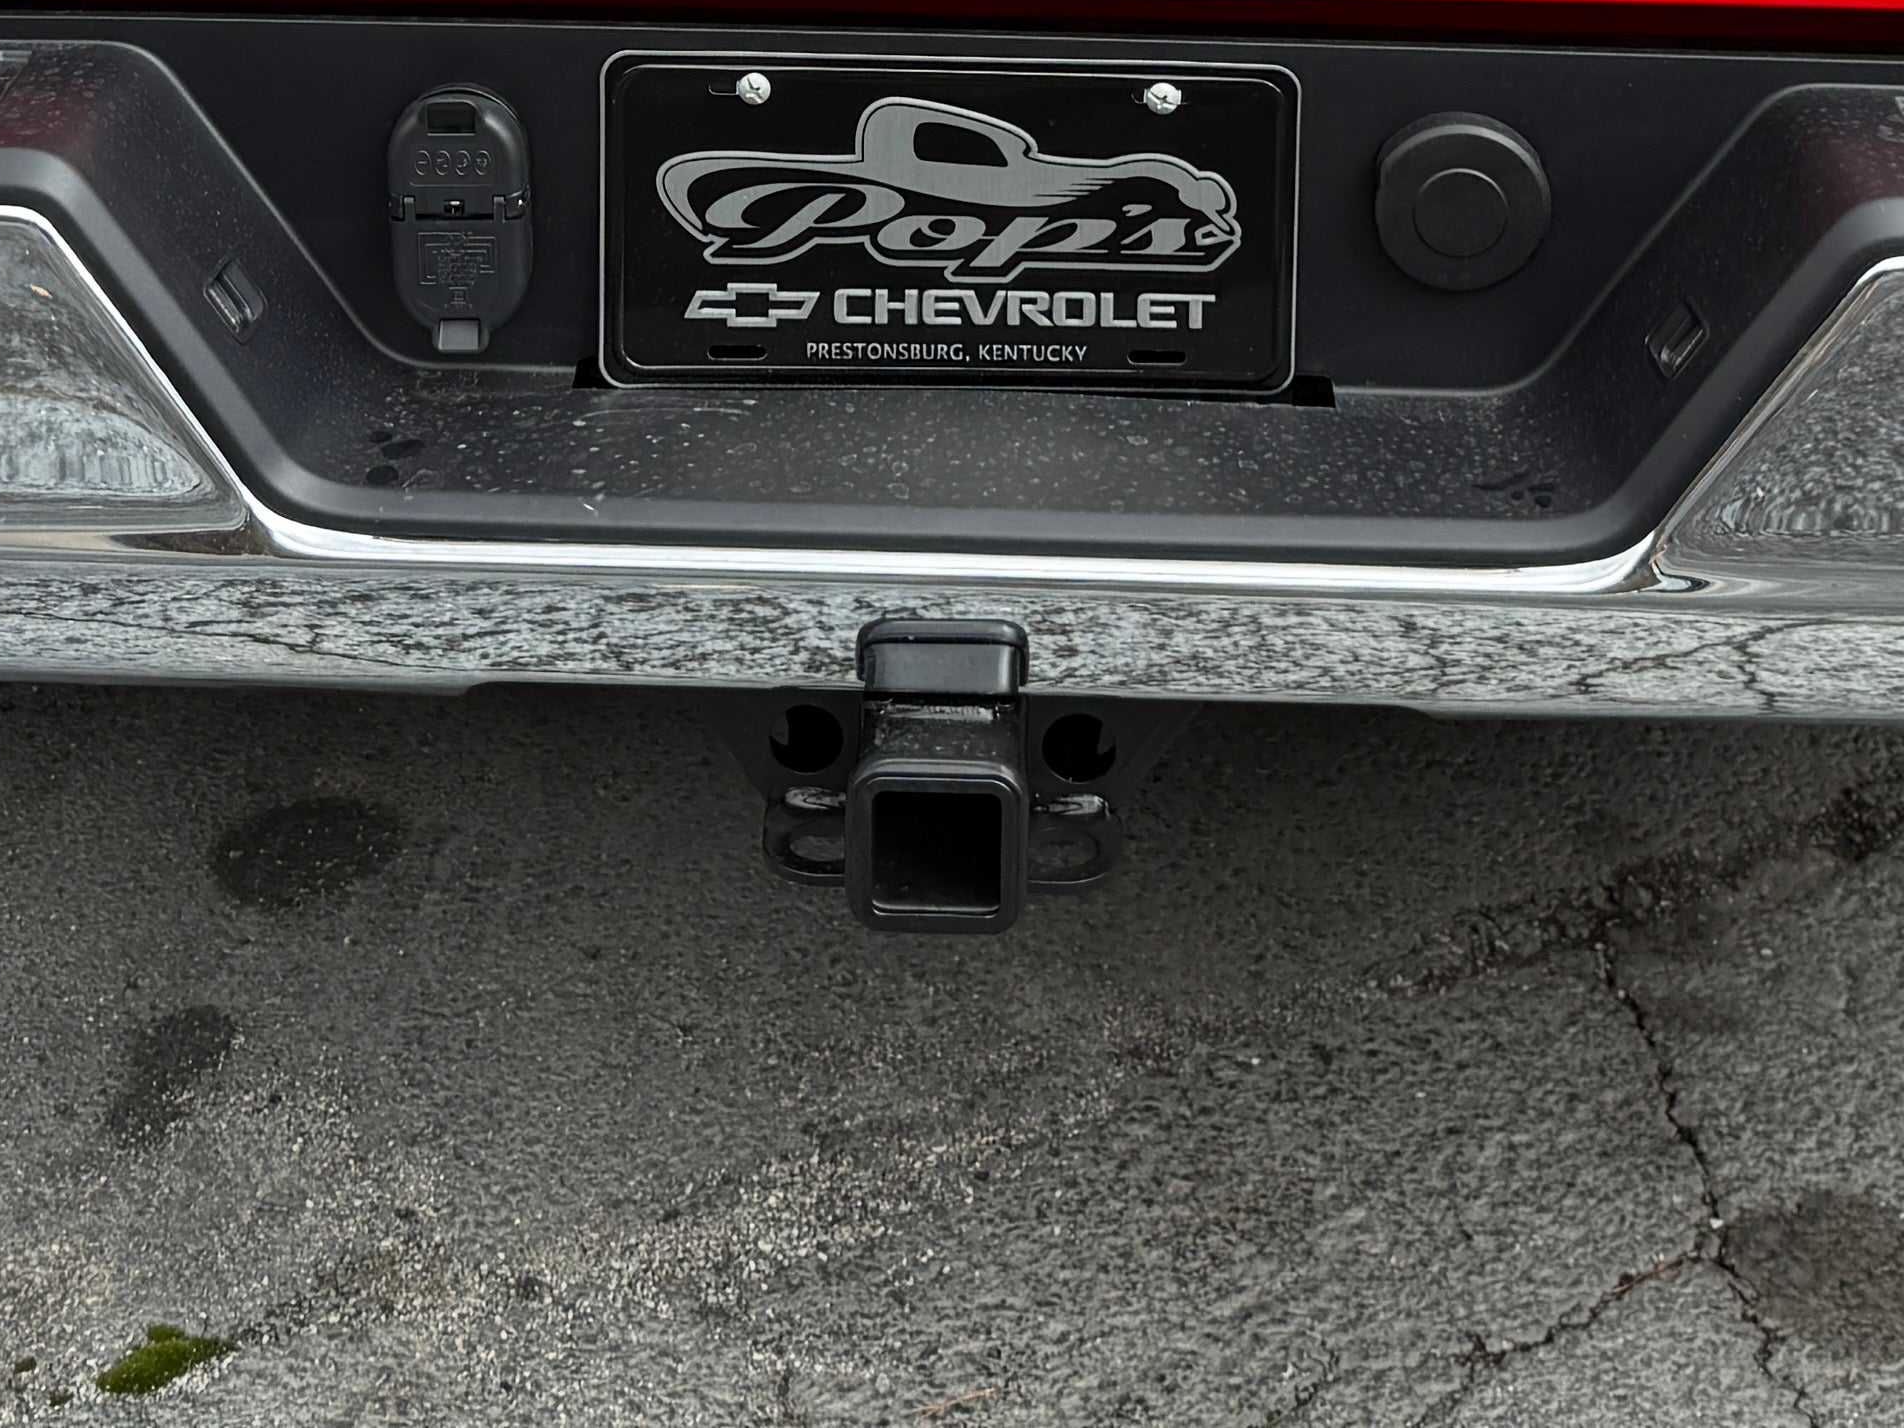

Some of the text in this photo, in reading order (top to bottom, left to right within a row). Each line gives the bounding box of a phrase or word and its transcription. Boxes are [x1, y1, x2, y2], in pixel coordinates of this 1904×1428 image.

[704, 182, 1208, 267] Pop's
[833, 287, 1216, 330] CHEVROLET
[806, 342, 1088, 363] PRESTONSBURG, KENTUCKY
